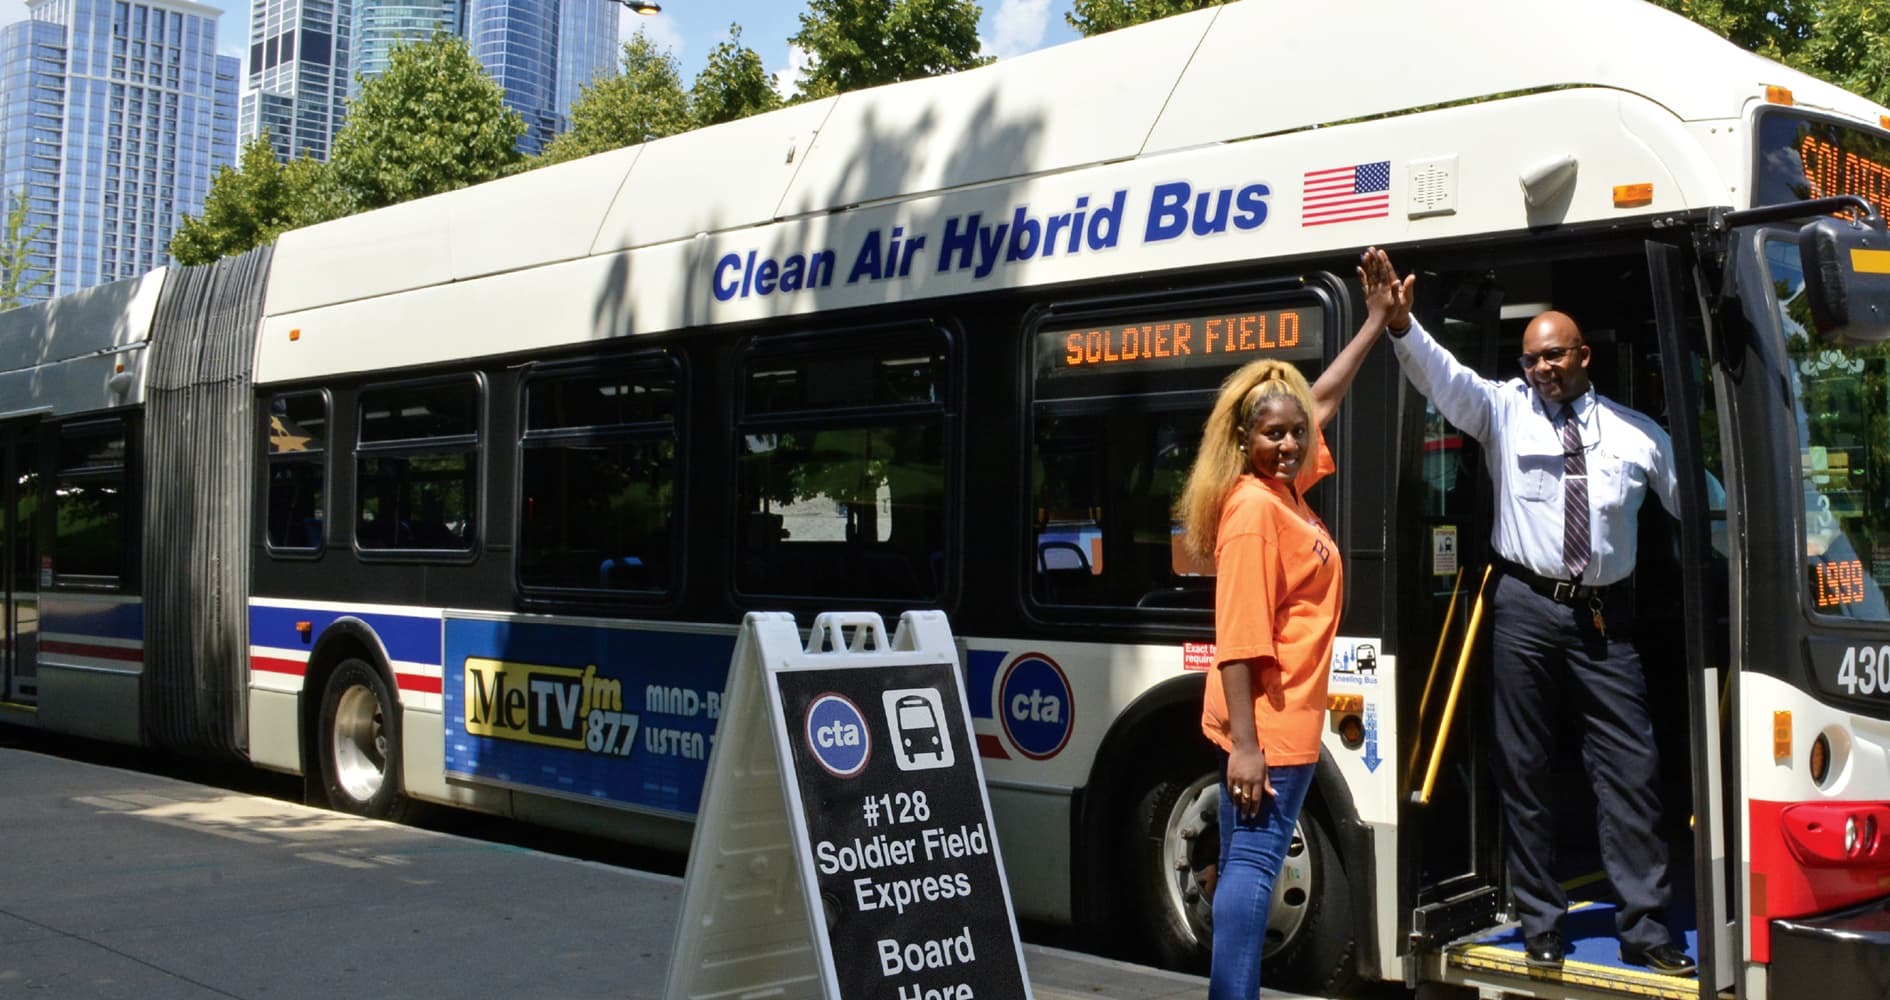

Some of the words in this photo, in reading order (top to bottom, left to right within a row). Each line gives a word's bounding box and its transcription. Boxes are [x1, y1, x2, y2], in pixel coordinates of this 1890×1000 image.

[713, 250, 836, 302] Clean
[847, 226, 926, 283] Air
[937, 190, 1128, 280] Hybrid
[1144, 181, 1271, 243] Bus
[1066, 322, 1193, 366] SOLDIER
[1205, 311, 1301, 354] FIELD
[1816, 560, 1865, 607] 1999
[1185, 642, 1208, 654] Exact
[1837, 645, 1890, 695] 430
[580, 664, 622, 719] fm
[645, 684, 727, 720] MIND-B
[1011, 689, 1060, 723] cta
[586, 709, 639, 757] 87.7
[645, 727, 704, 760] LISTEN
[816, 720, 860, 749] cta
[863, 790, 930, 827] #128
[816, 833, 916, 875] Soldier
[921, 823, 988, 861] Field
[854, 872, 972, 914] Express
[877, 926, 975, 977] Board
